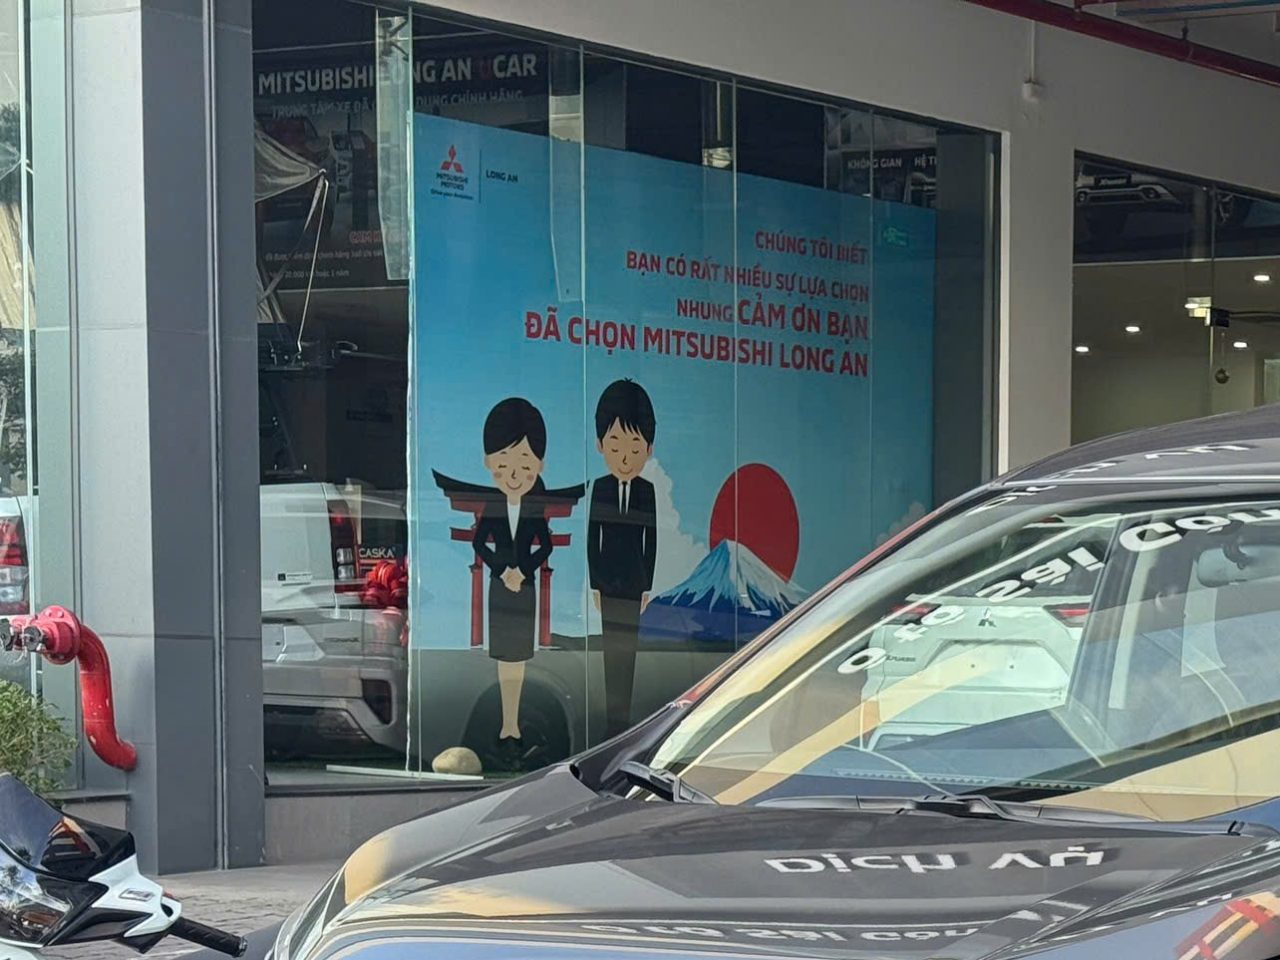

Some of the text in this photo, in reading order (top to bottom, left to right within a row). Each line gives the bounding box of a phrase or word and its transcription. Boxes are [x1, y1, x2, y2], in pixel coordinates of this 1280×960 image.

[258, 66, 374, 95] MITSUBISHI
[442, 57, 472, 81] AN
[485, 169, 519, 183] LONG AN
[880, 158, 902, 168] GIAN
[755, 230, 807, 256] CHÚNG
[810, 236, 833, 259] TÔI
[626, 251, 661, 276] BẠN
[666, 253, 687, 276] CÓ
[690, 256, 720, 281] RẤT
[776, 273, 796, 297] SỰ
[800, 276, 827, 299] LỰA
[831, 281, 869, 305] CHỌN
[737, 293, 786, 329] CẢM
[791, 304, 821, 334] ƠN
[827, 311, 868, 344] BẠN
[525, 307, 868, 377] ĐÃ CHỌN MITSUBISHI LONG AN
